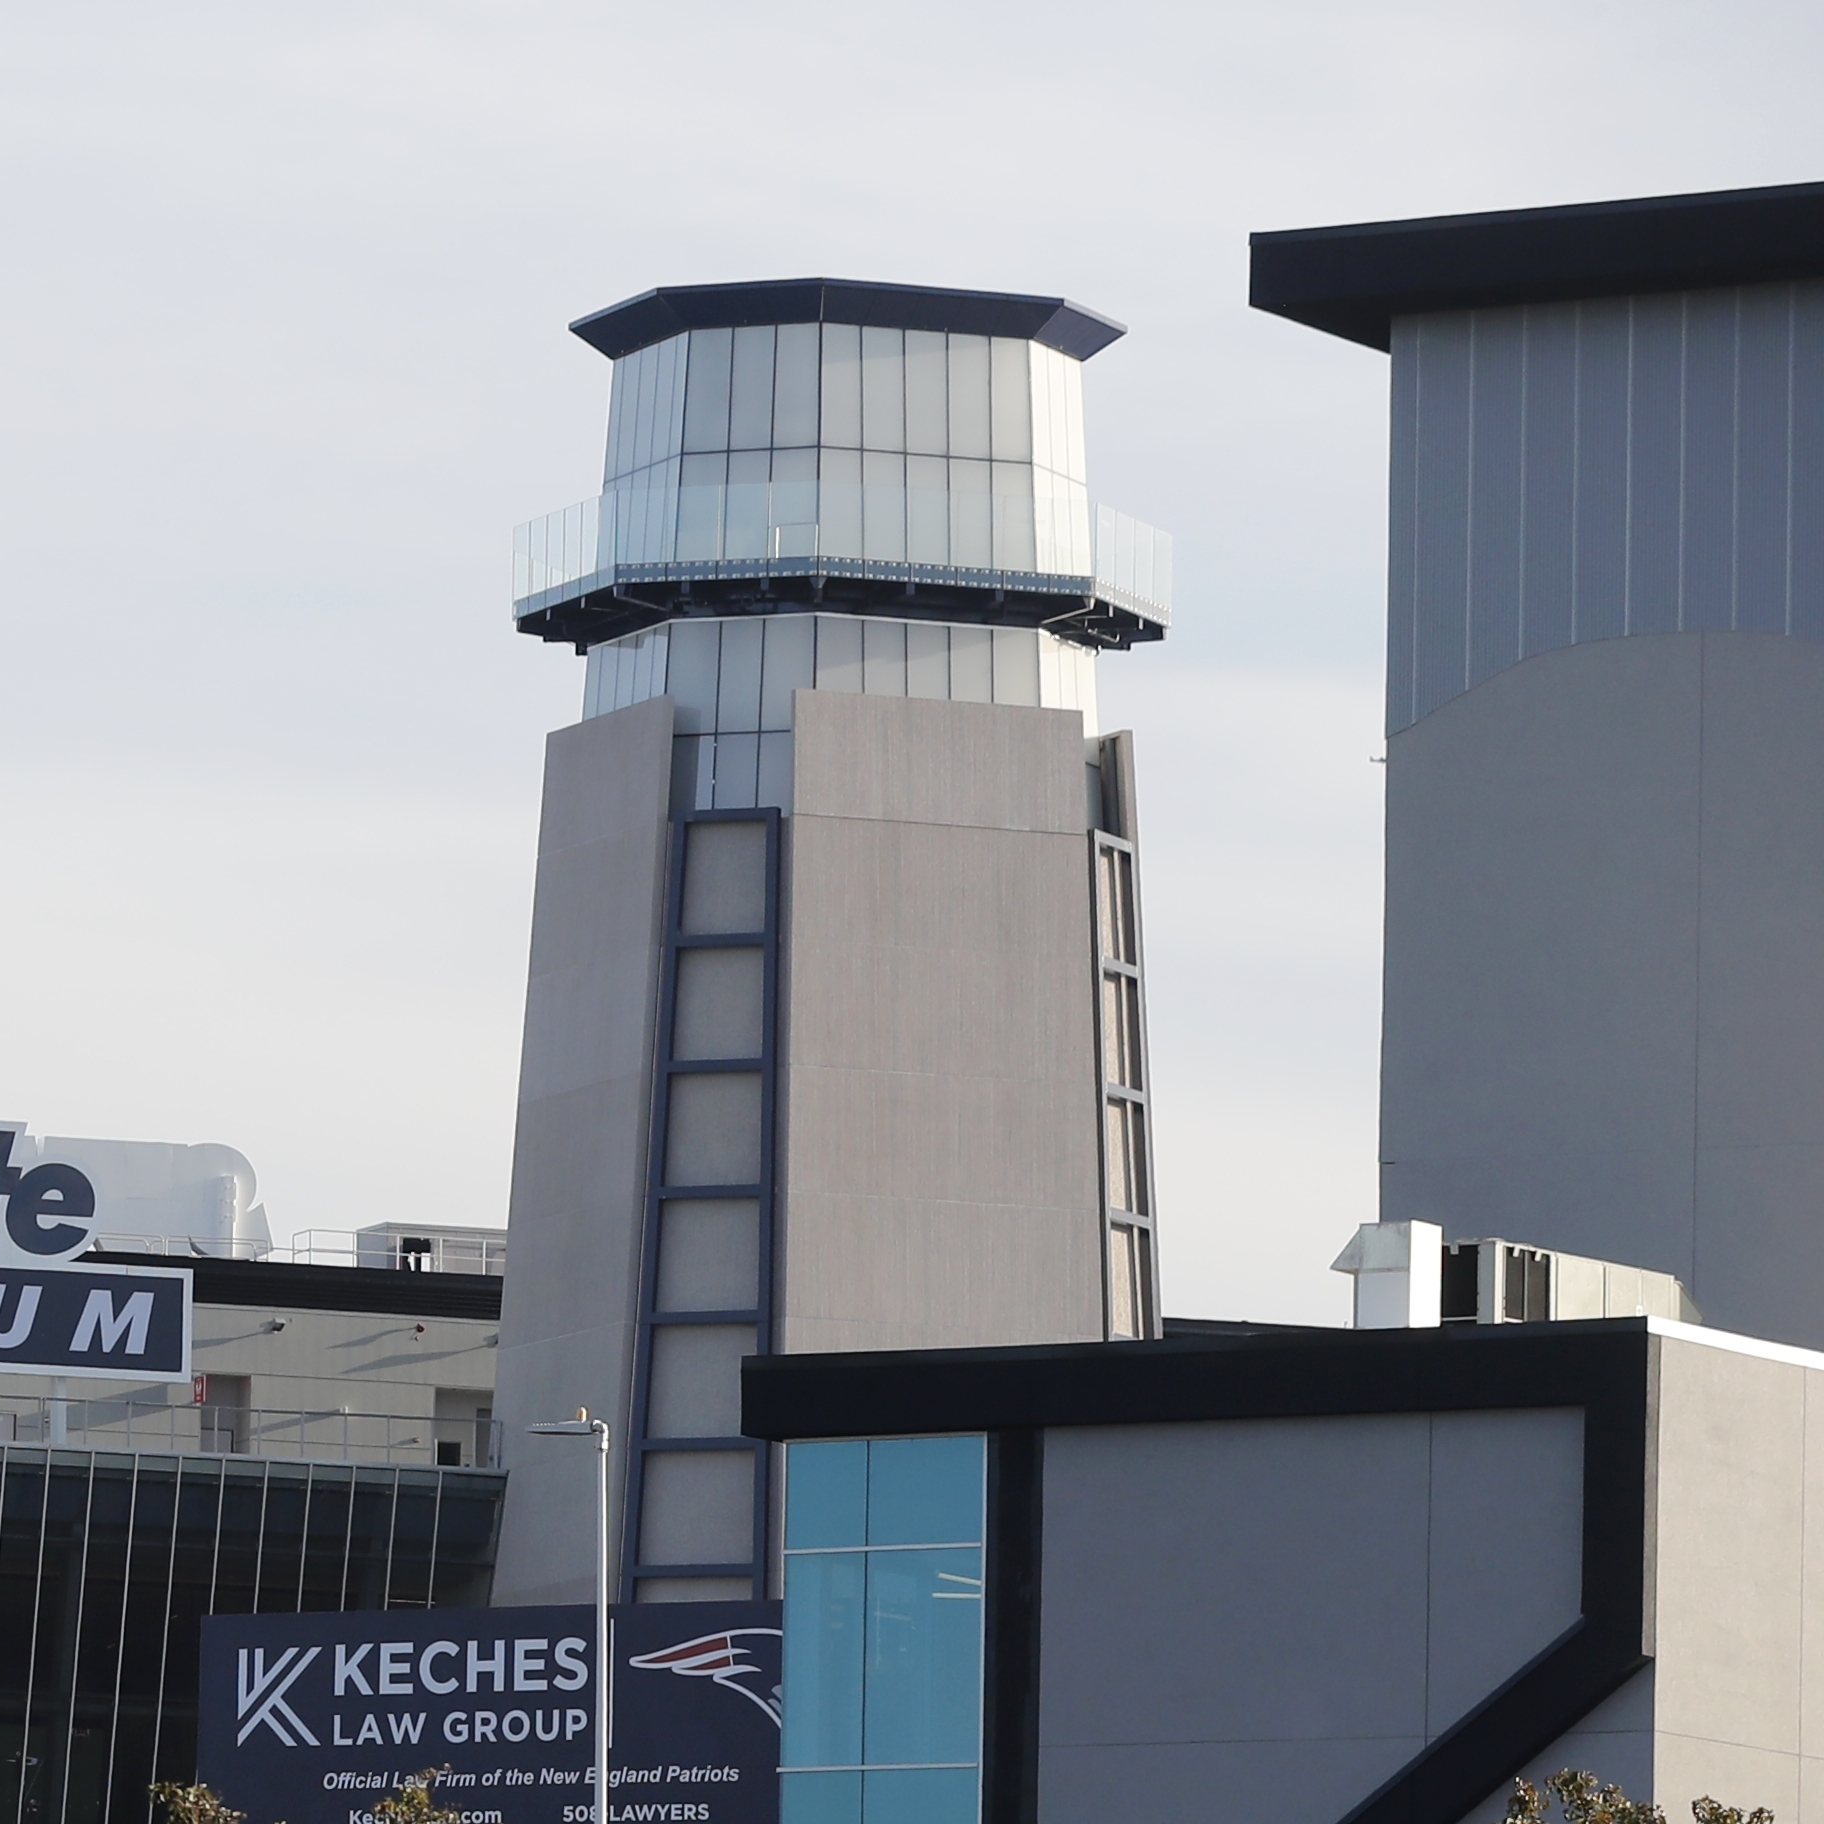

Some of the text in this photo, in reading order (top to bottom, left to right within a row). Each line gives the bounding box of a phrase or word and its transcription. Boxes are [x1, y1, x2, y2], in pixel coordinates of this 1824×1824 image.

[333, 1636, 589, 1697] KECHES
[332, 1707, 589, 1747] LAW GROUP
[323, 1771, 388, 1790] Official
[435, 1769, 476, 1787] Firm
[481, 1769, 503, 1787] of
[506, 1769, 534, 1786] the
[539, 1768, 580, 1785] New
[584, 1766, 663, 1788] Egland
[666, 1764, 740, 1784] Patriots
[562, 1803, 710, 1823] 508LAWYERS
